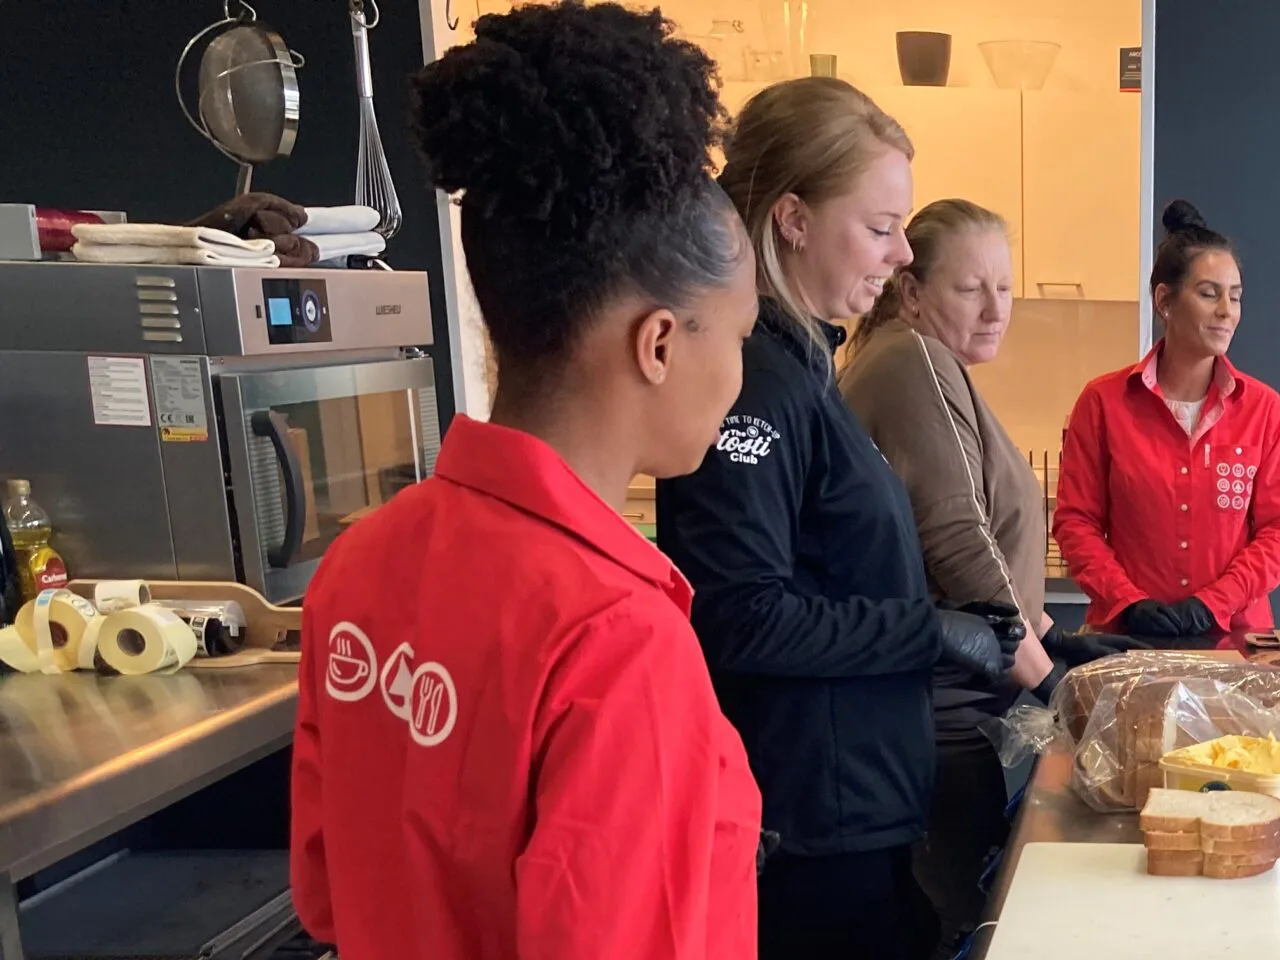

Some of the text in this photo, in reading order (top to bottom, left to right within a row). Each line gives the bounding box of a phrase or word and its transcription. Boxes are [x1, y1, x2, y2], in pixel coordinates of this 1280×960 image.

[743, 415, 752, 424] TO
[730, 429, 746, 437] The
[716, 430, 771, 456] tosti
[730, 452, 758, 464] Club
